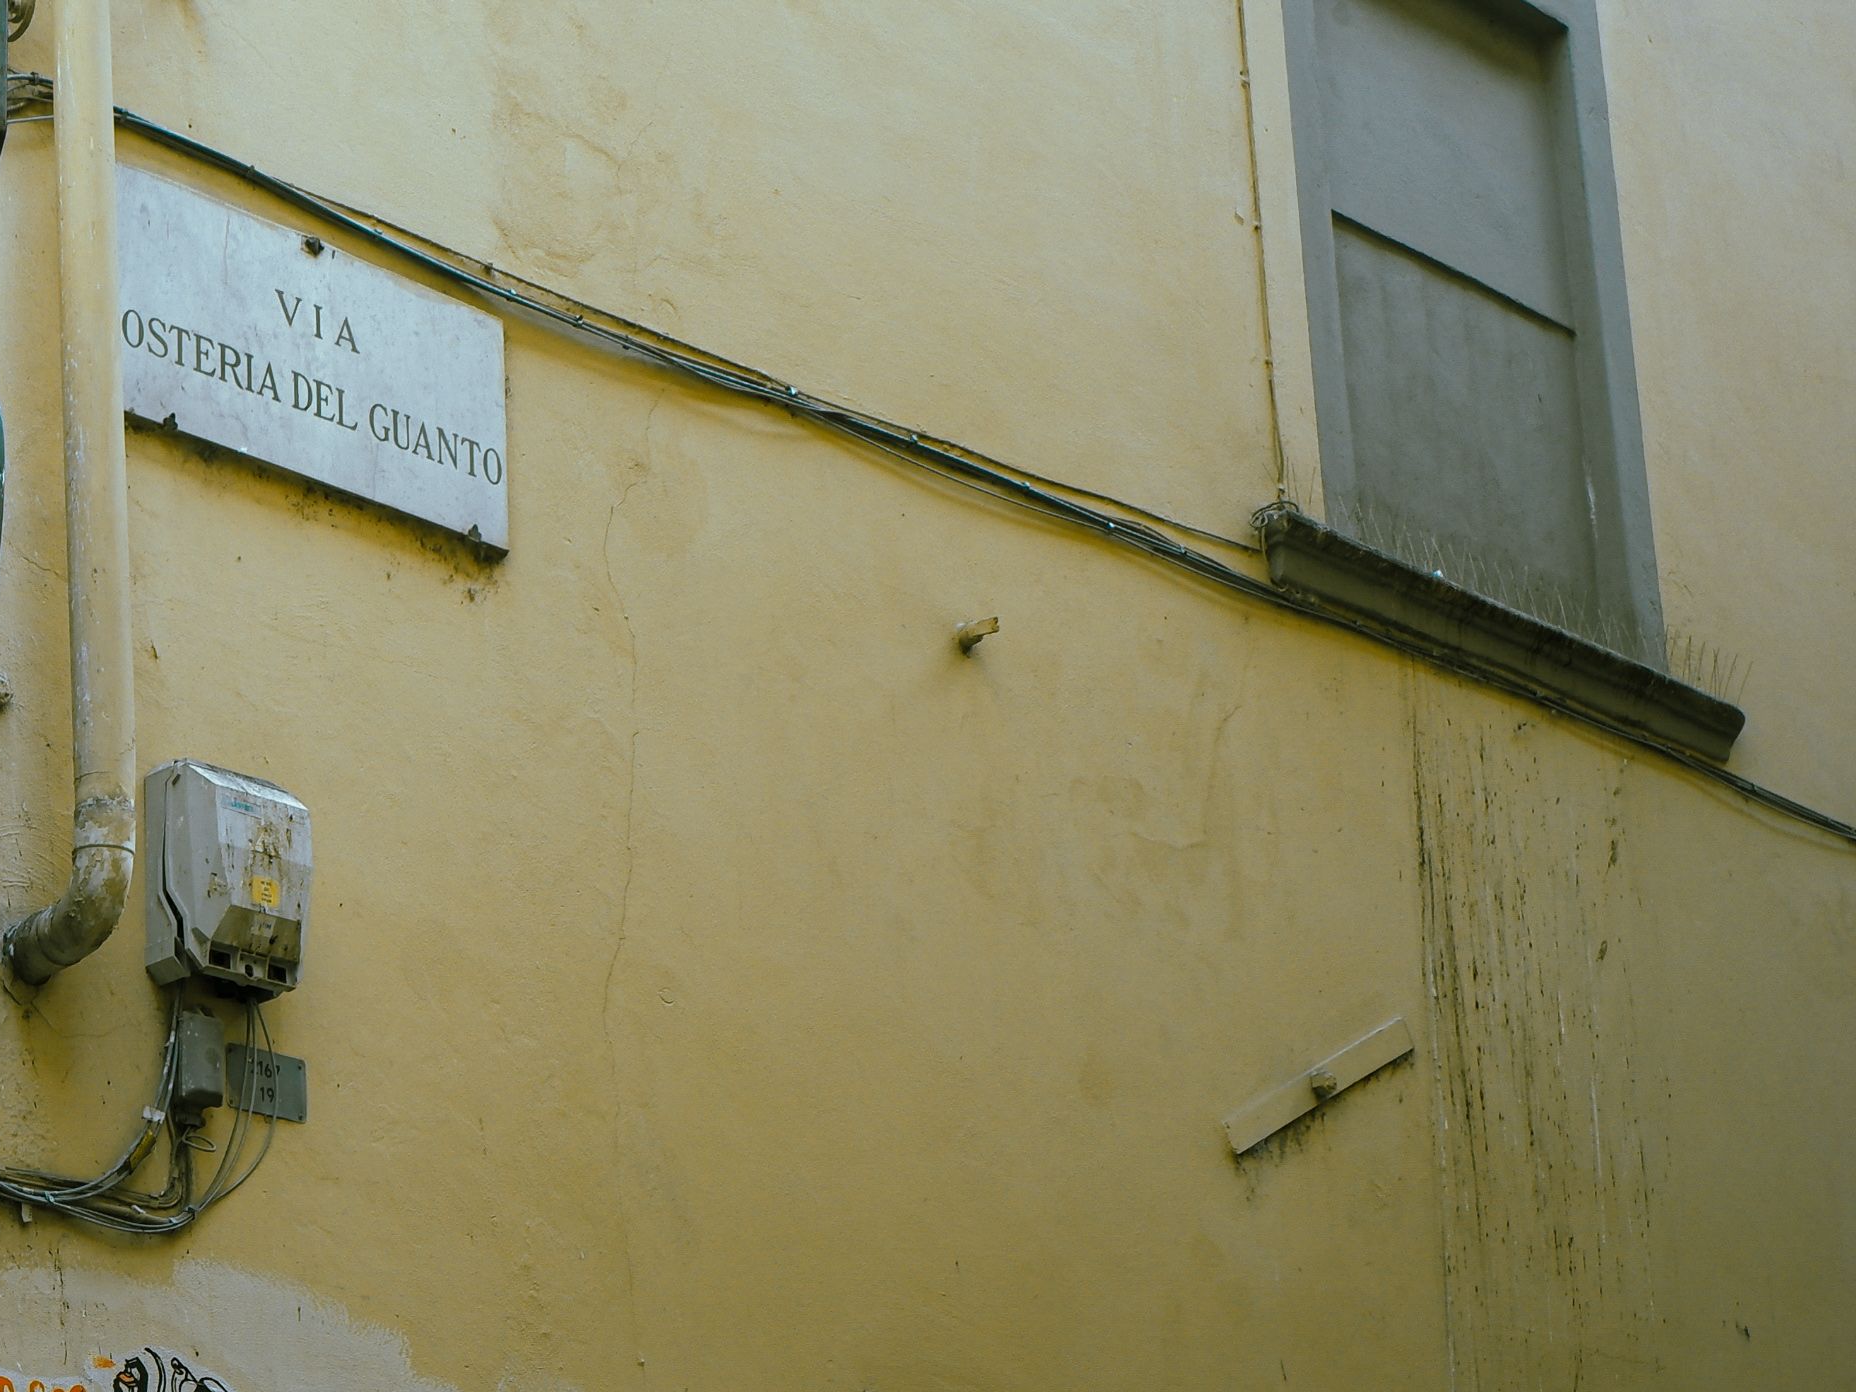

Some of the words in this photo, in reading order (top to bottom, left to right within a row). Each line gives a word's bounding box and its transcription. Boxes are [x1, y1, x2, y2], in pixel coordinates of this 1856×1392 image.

[274, 288, 361, 355] VIA
[121, 308, 282, 403] OSTERIA
[291, 369, 359, 432] DEL
[368, 402, 504, 487] GUANTO
[260, 1088, 276, 1104] 19
